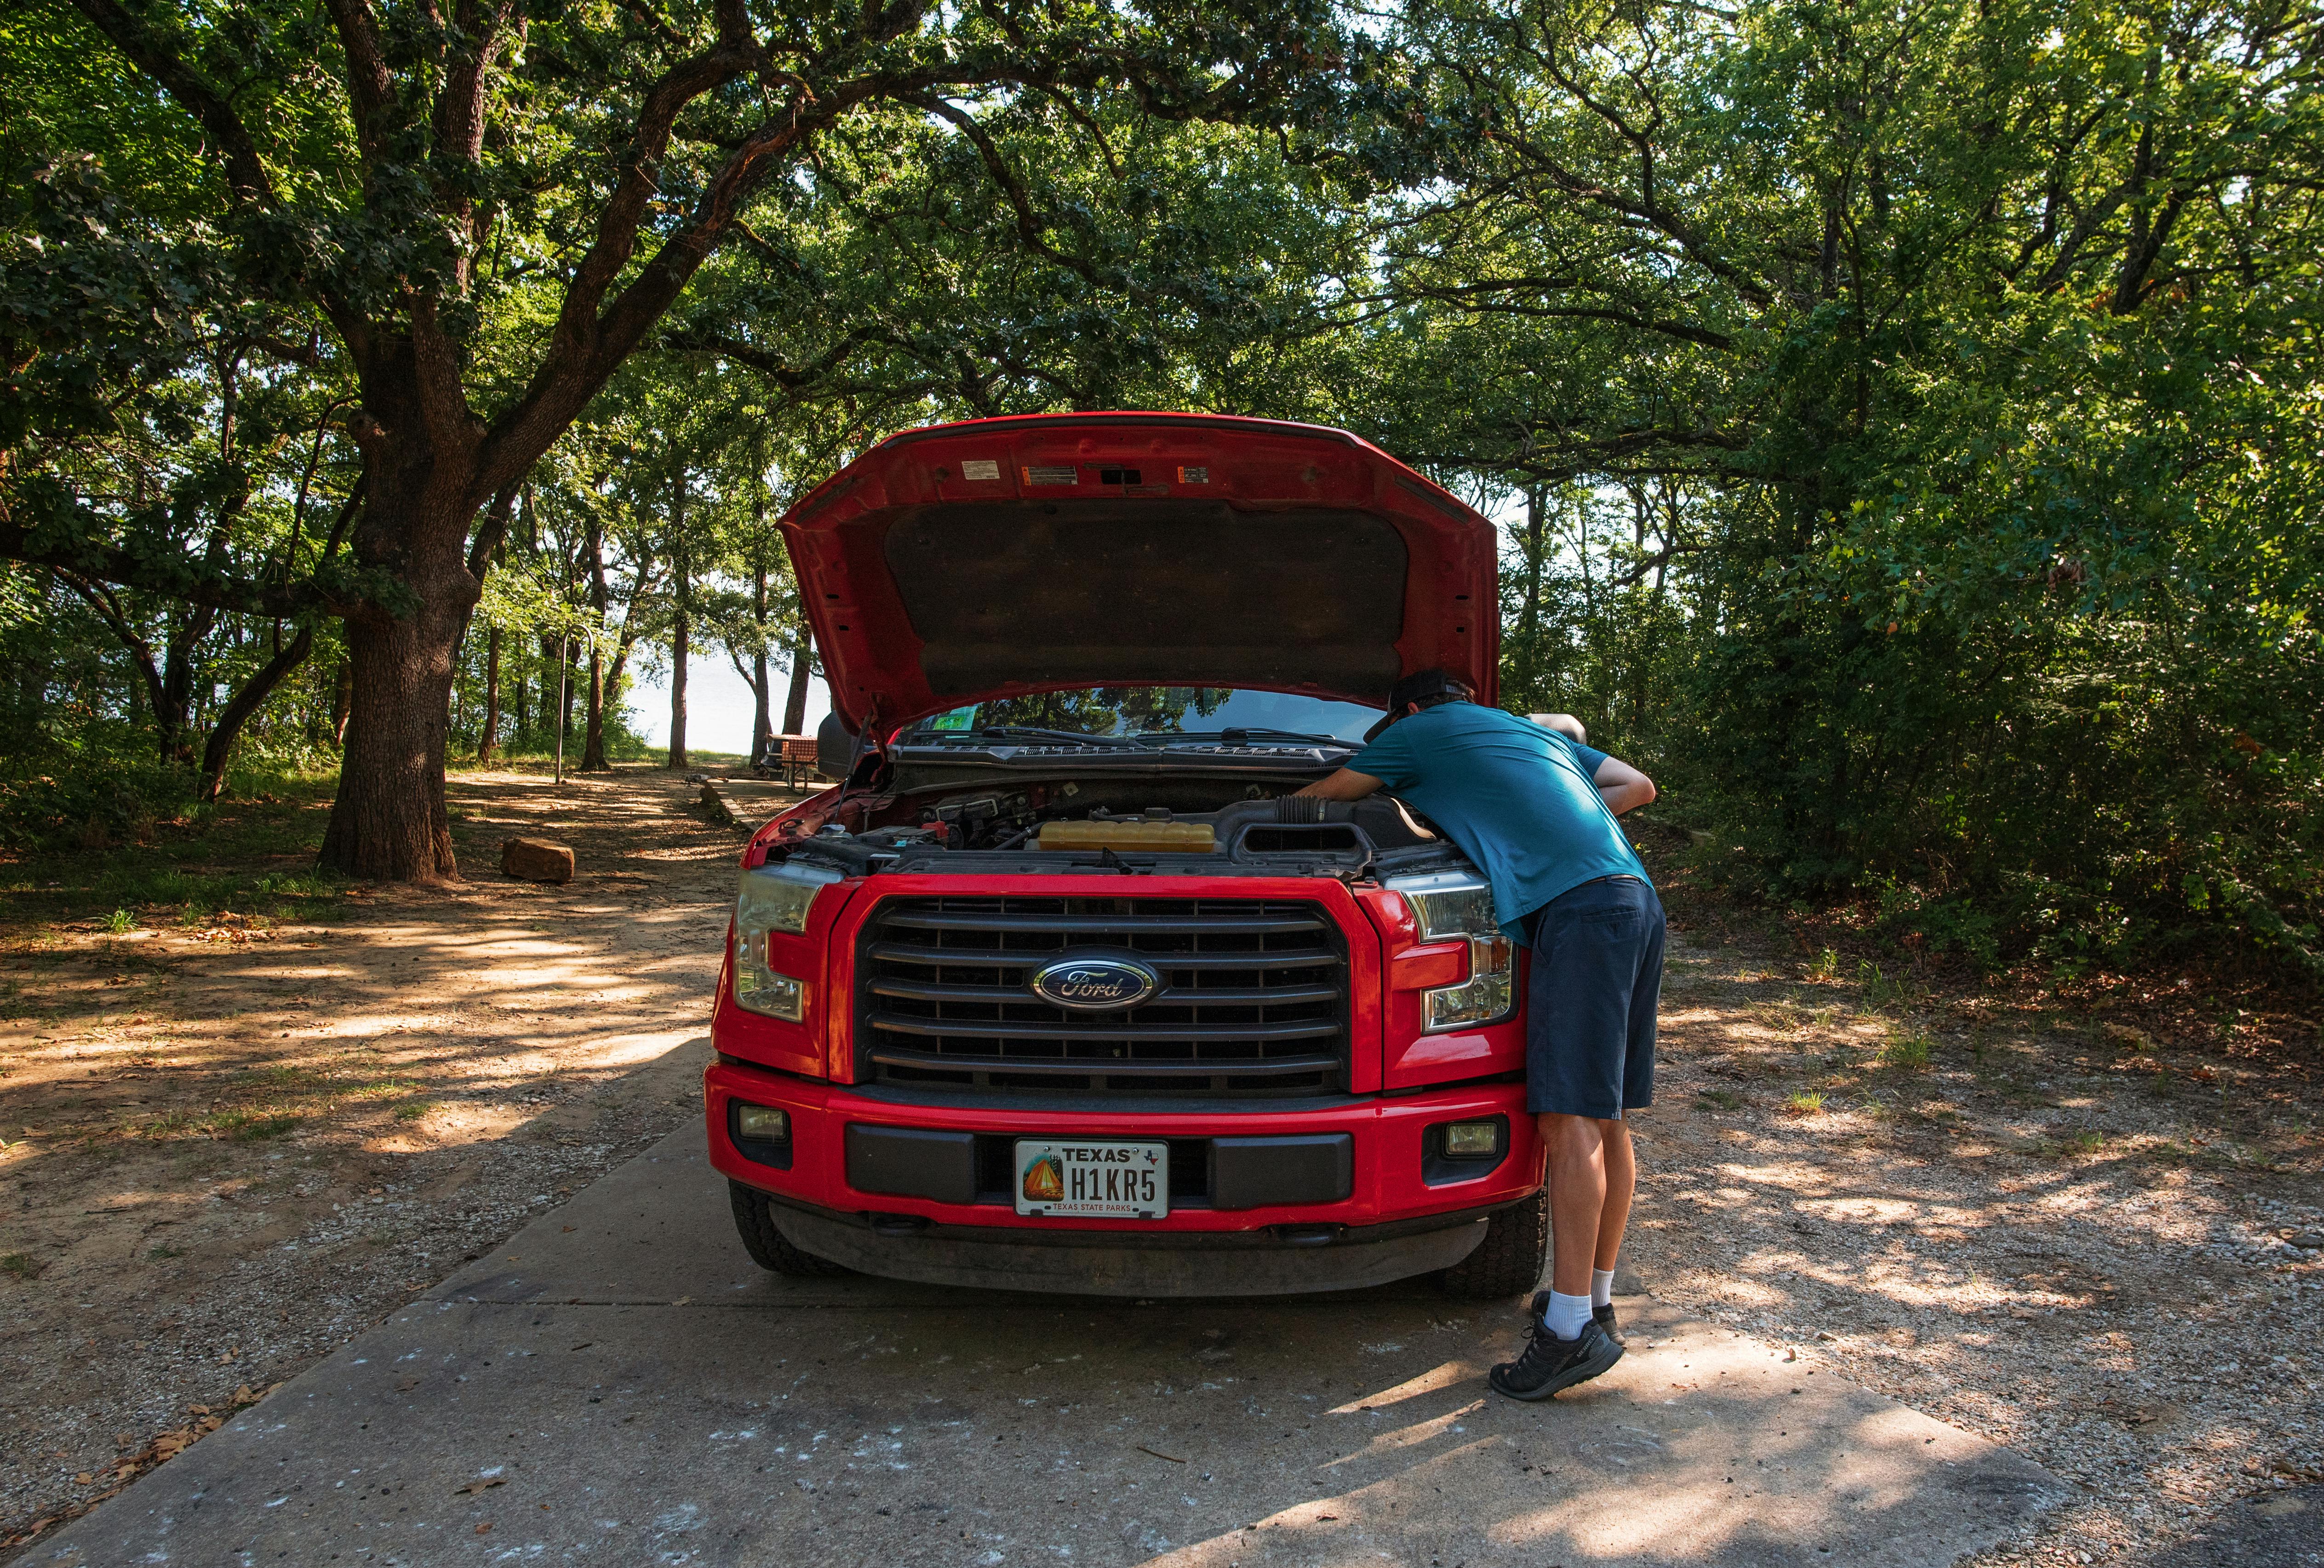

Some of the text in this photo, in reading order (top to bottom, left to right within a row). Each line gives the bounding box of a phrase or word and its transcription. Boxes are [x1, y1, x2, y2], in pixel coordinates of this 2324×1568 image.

[1061, 970, 1123, 996] Ford
[1062, 1148, 1130, 1163] TEXAS
[1072, 1168, 1155, 1202] H1KR5
[1576, 1334, 1597, 1358] MERRELL
